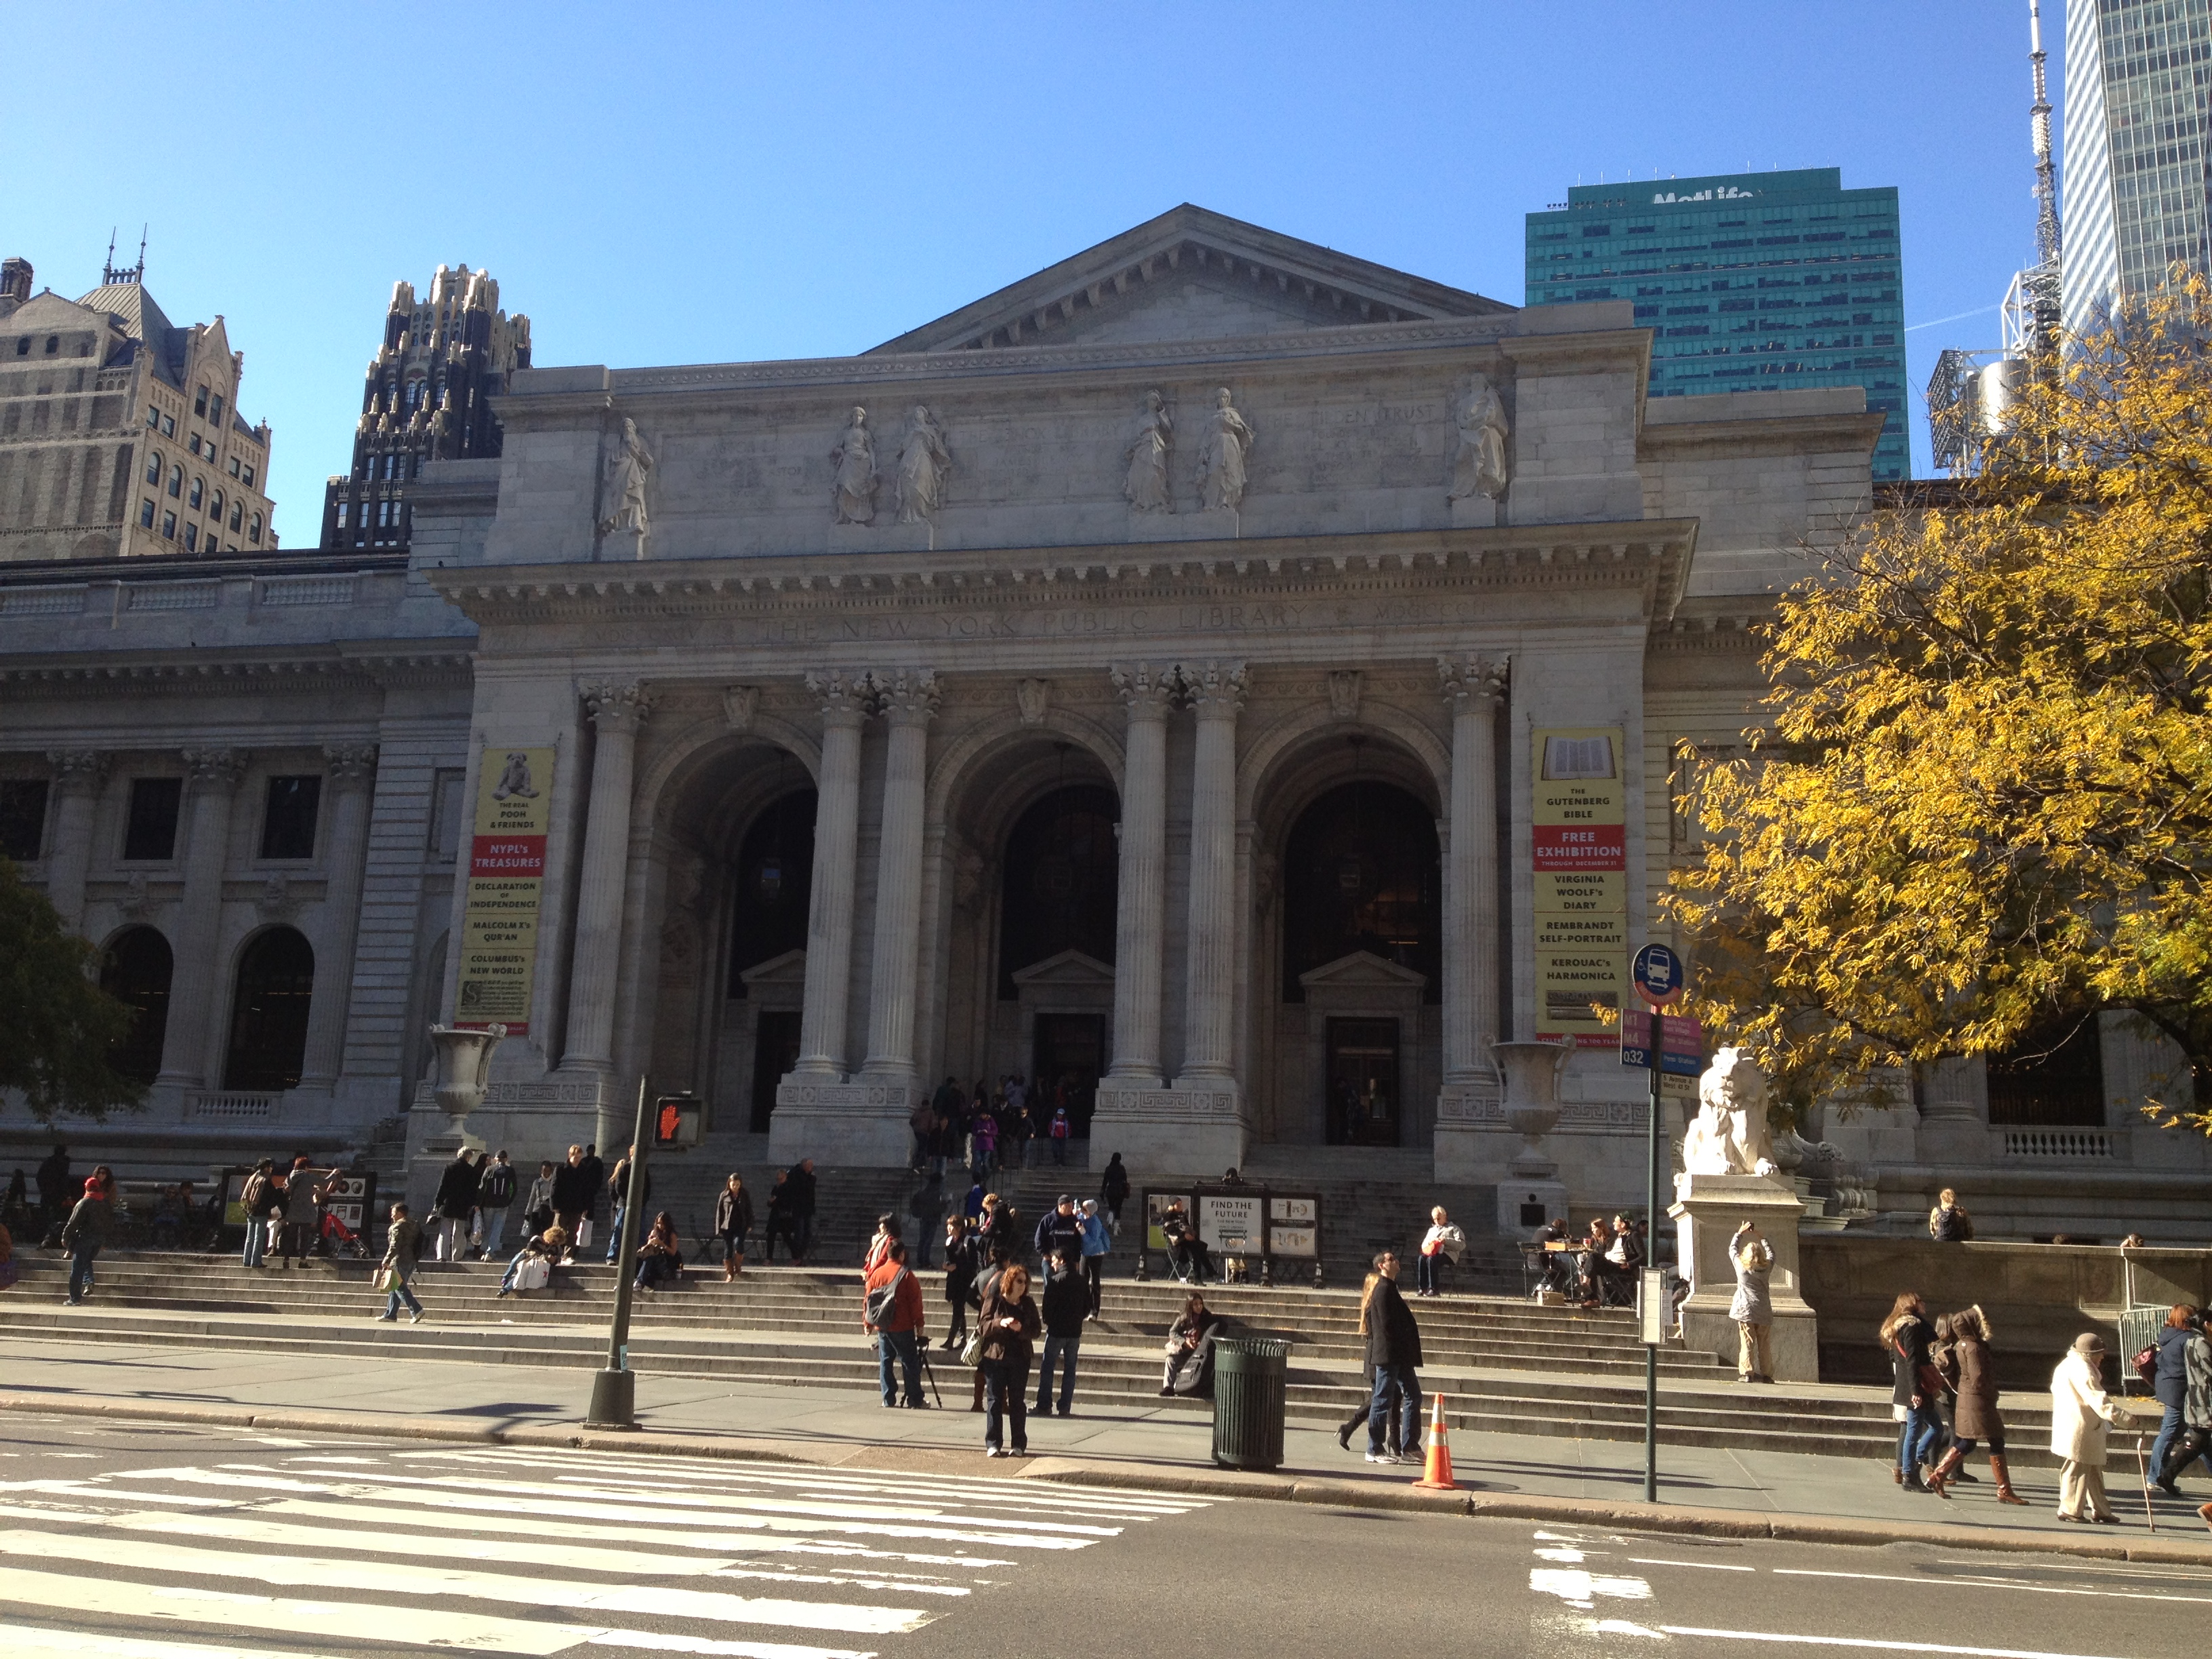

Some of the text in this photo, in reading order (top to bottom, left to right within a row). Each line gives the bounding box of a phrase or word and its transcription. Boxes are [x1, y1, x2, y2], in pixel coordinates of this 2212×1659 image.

[1382, 403, 1436, 422] TRUST
[762, 619, 818, 640] THE
[842, 617, 914, 638] NEW
[941, 615, 1019, 636] YORK
[1042, 611, 1149, 632] PUBLIC
[1178, 605, 1309, 629] LIBRARY
[1547, 798, 1610, 806] GUTENBERG
[1561, 832, 1595, 842] FREE
[490, 844, 529, 854] NYPL's
[1537, 846, 1621, 857] EXHIBITION
[475, 857, 541, 867] TREASURES
[1557, 888, 1603, 897] WOOLF's
[1563, 901, 1597, 909] DIARY
[1547, 922, 1614, 930] REMBRANDT
[484, 934, 518, 942] QUR'AN
[1540, 935, 1622, 943] SELF-PORTRAIT
[1551, 958, 1611, 967] KEROUAC's
[1547, 972, 1616, 981] HARMONICA
[1624, 1032, 1639, 1044] M4
[1623, 1050, 1644, 1065] Q32
[1210, 1201, 1252, 1210] FIND THE
[1215, 1210, 1248, 1218] FUTURE
